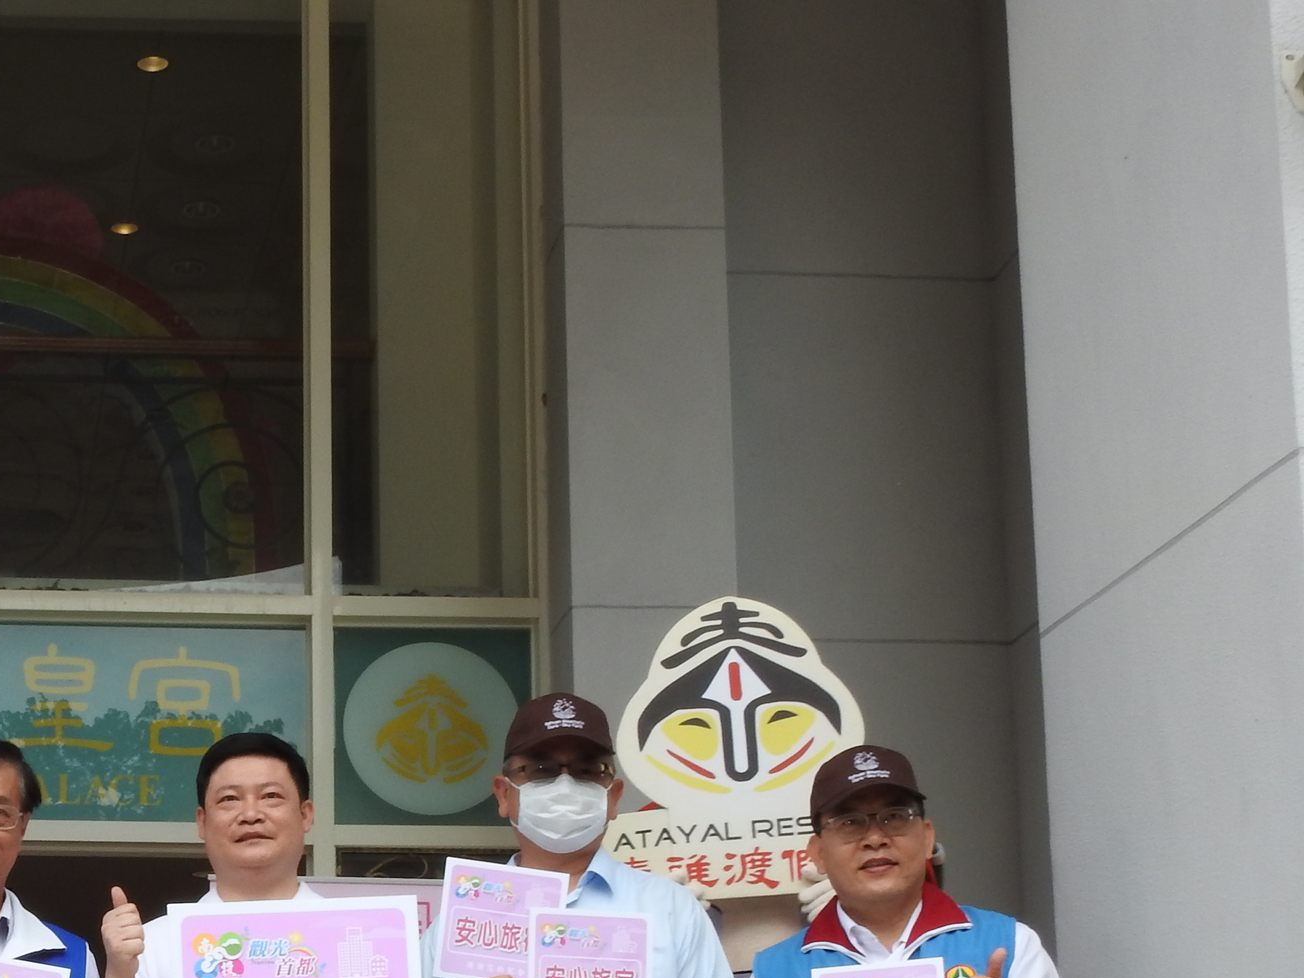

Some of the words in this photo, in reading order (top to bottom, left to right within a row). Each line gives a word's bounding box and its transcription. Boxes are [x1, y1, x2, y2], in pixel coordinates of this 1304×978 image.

[613, 821, 743, 853] ATAYAL
[454, 916, 528, 953] 安心旅
